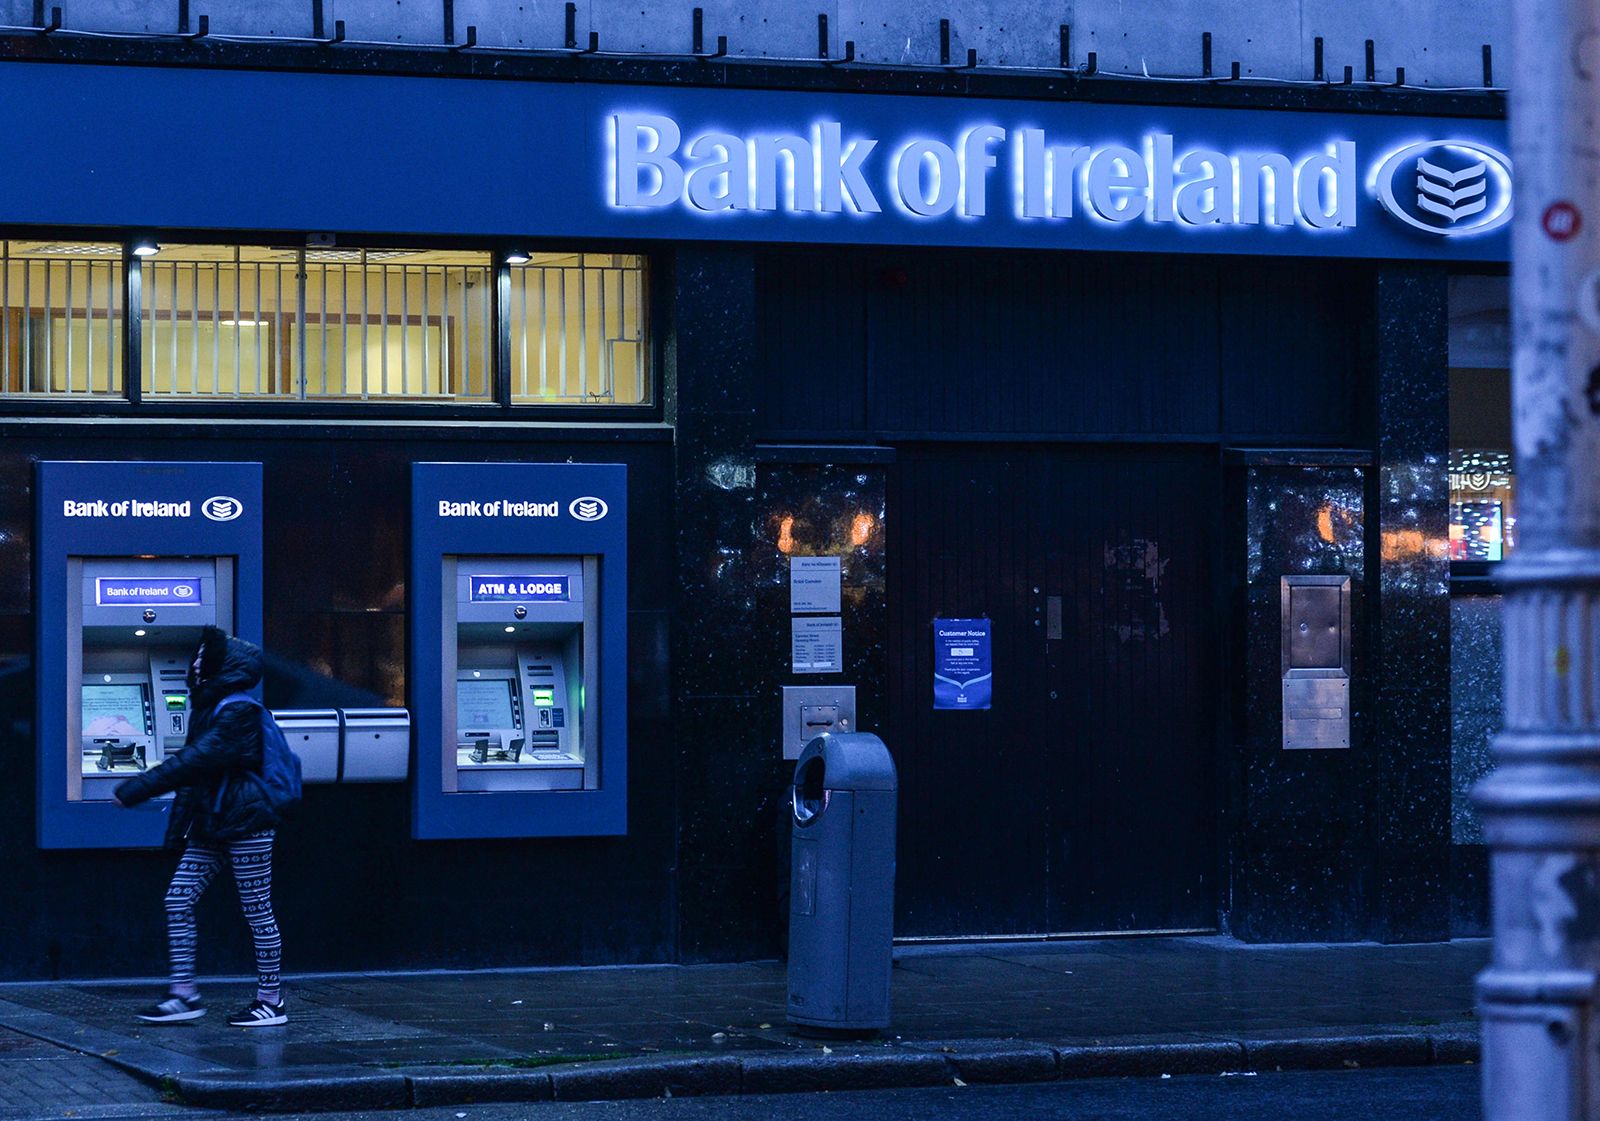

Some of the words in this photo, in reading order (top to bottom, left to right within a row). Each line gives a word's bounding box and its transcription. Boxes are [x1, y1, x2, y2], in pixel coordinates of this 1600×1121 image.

[605, 112, 881, 214] Bank
[890, 124, 1007, 220] of
[1013, 127, 1357, 231] Ireland
[63, 500, 109, 517] Bank
[110, 499, 130, 517] of
[131, 499, 191, 517] Ireland
[438, 500, 482, 517] Bank
[483, 500, 501, 517] of
[503, 499, 559, 517] Ireland
[106, 586, 129, 596] Bank
[129, 586, 140, 596] of
[139, 586, 169, 597] Ireland
[478, 583, 505, 595] ATM
[508, 583, 517, 595] &
[520, 583, 562, 595] LODGE
